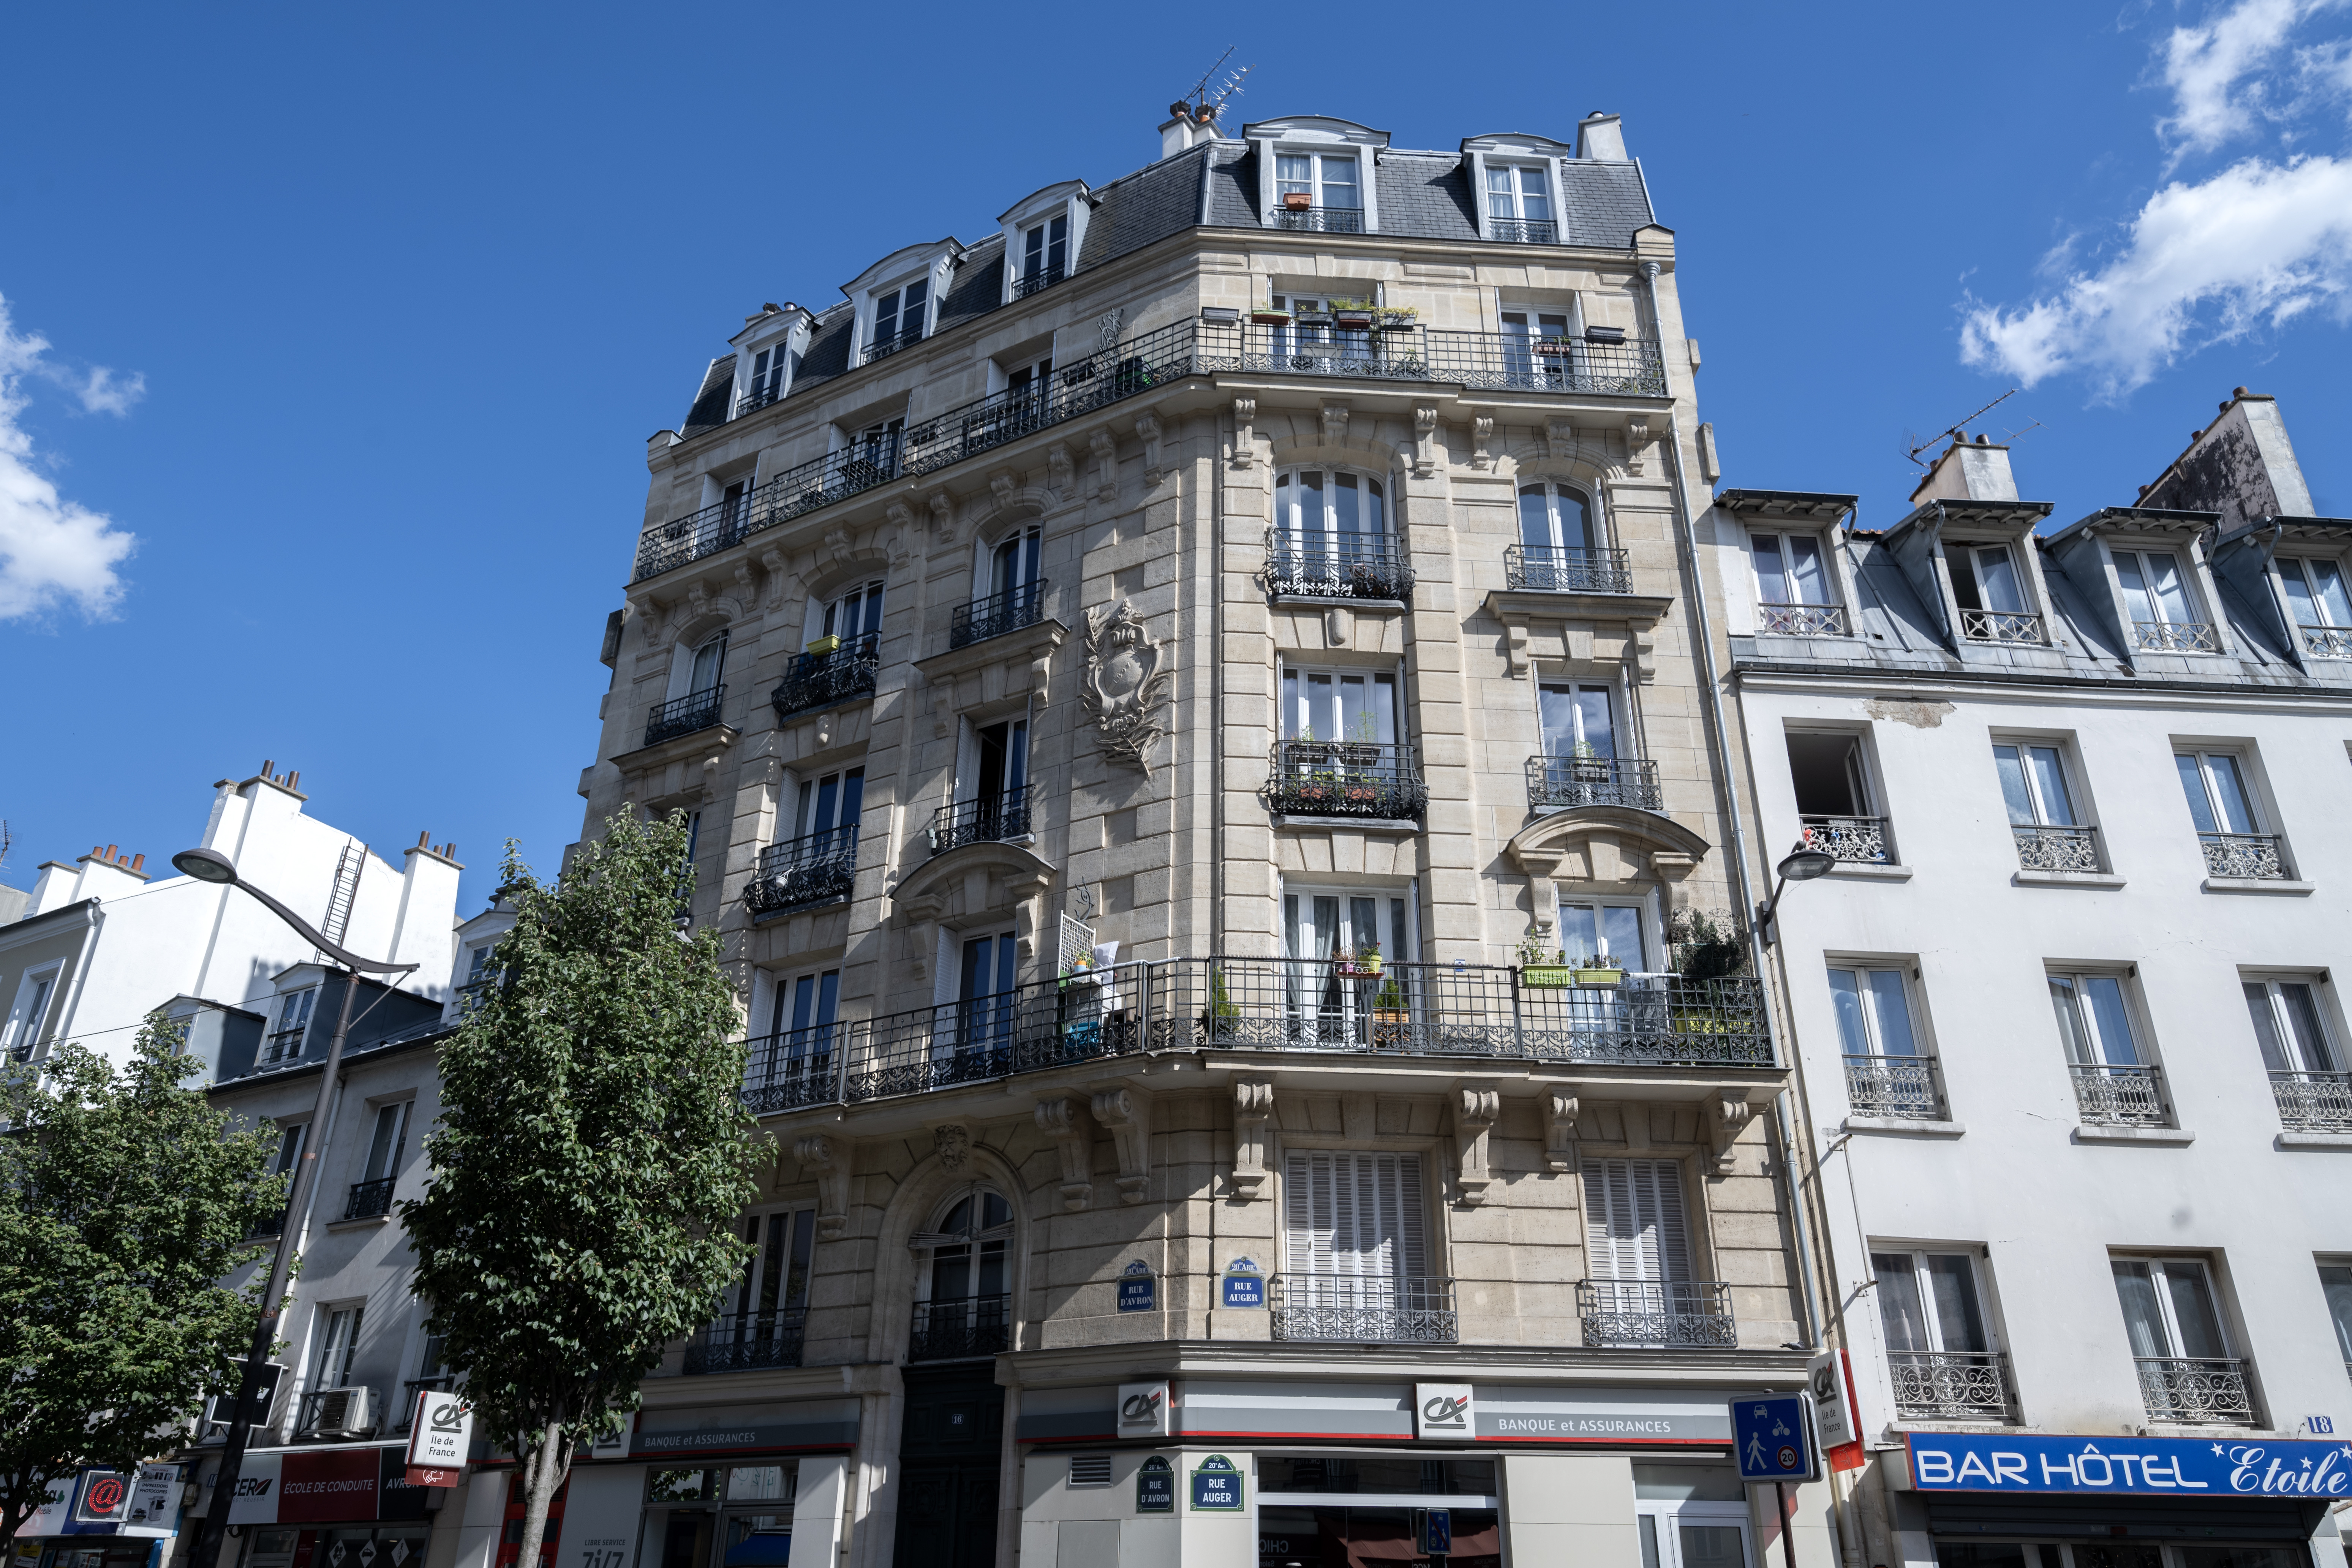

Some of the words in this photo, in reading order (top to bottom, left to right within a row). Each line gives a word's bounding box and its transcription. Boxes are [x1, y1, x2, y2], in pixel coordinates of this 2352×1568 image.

[1129, 1285, 1143, 1294] RUE
[1121, 1296, 1152, 1306] D'AVRON
[1830, 1407, 1836, 1418] de
[1499, 1419, 1556, 1432] BANQUE
[1561, 1420, 1574, 1431] et
[1579, 1420, 1671, 1432] ASSURANCES
[1824, 1422, 1841, 1434] France
[431, 1435, 441, 1444] Île
[645, 1436, 681, 1448] BANQUE
[683, 1435, 692, 1445] et
[695, 1432, 755, 1445] ASSURANCES
[429, 1447, 455, 1457] France
[1782, 1453, 1793, 1462] 20
[1917, 1450, 2029, 1485] BAR
[2040, 1443, 2208, 1488] HÔTEL
[2229, 1446, 2348, 1493] Etoile
[284, 1481, 313, 1494] ÉCOLE
[313, 1482, 326, 1492] DE
[327, 1479, 374, 1492] CONDUITE
[1209, 1479, 1225, 1488] RUE
[1141, 1494, 1170, 1503] D'AVRON
[1203, 1492, 1231, 1502] AUGER
